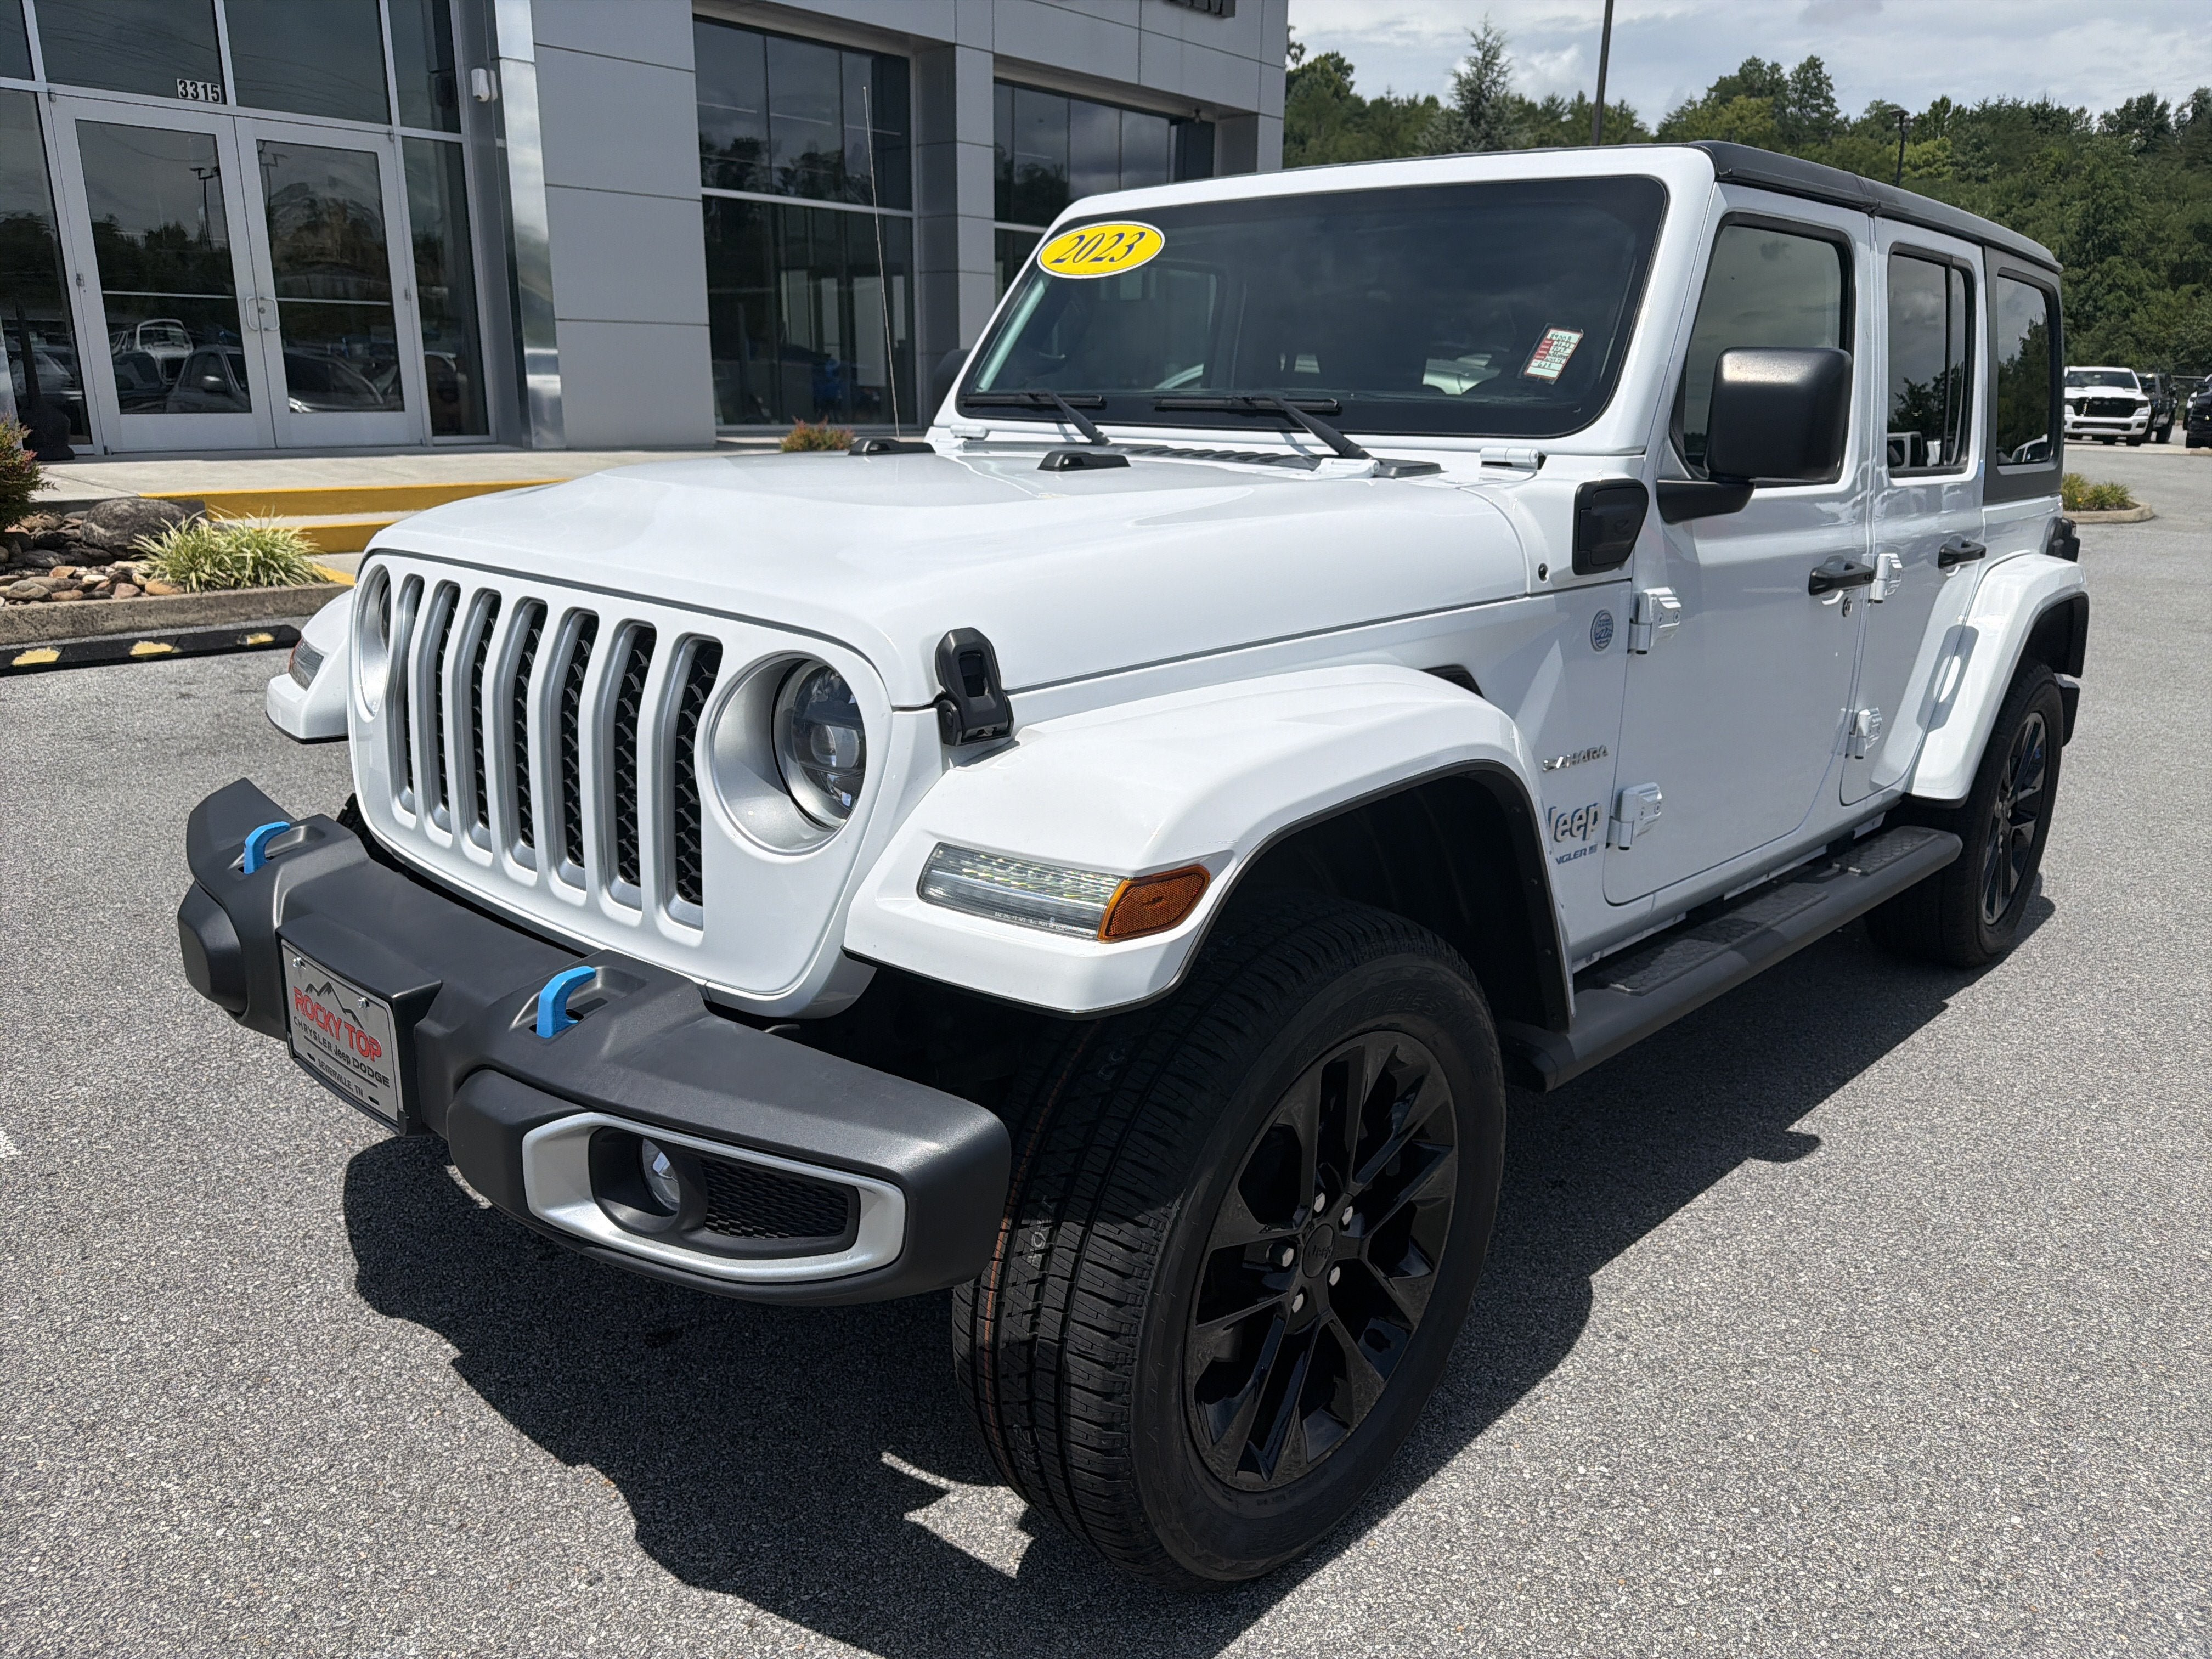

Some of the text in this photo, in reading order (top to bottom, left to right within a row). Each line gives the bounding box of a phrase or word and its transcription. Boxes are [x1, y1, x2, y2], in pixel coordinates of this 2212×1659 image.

[178, 80, 220, 103] 3315
[1049, 231, 1146, 264] 2023
[1542, 745, 1609, 772] SAHARA
[1548, 803, 1602, 843] Jeep
[294, 986, 382, 1062] ROCKY TOP
[294, 1016, 390, 1088] CHRYSLER Jeep DODGE
[318, 1058, 364, 1097] SEVIERVILLE, TN
